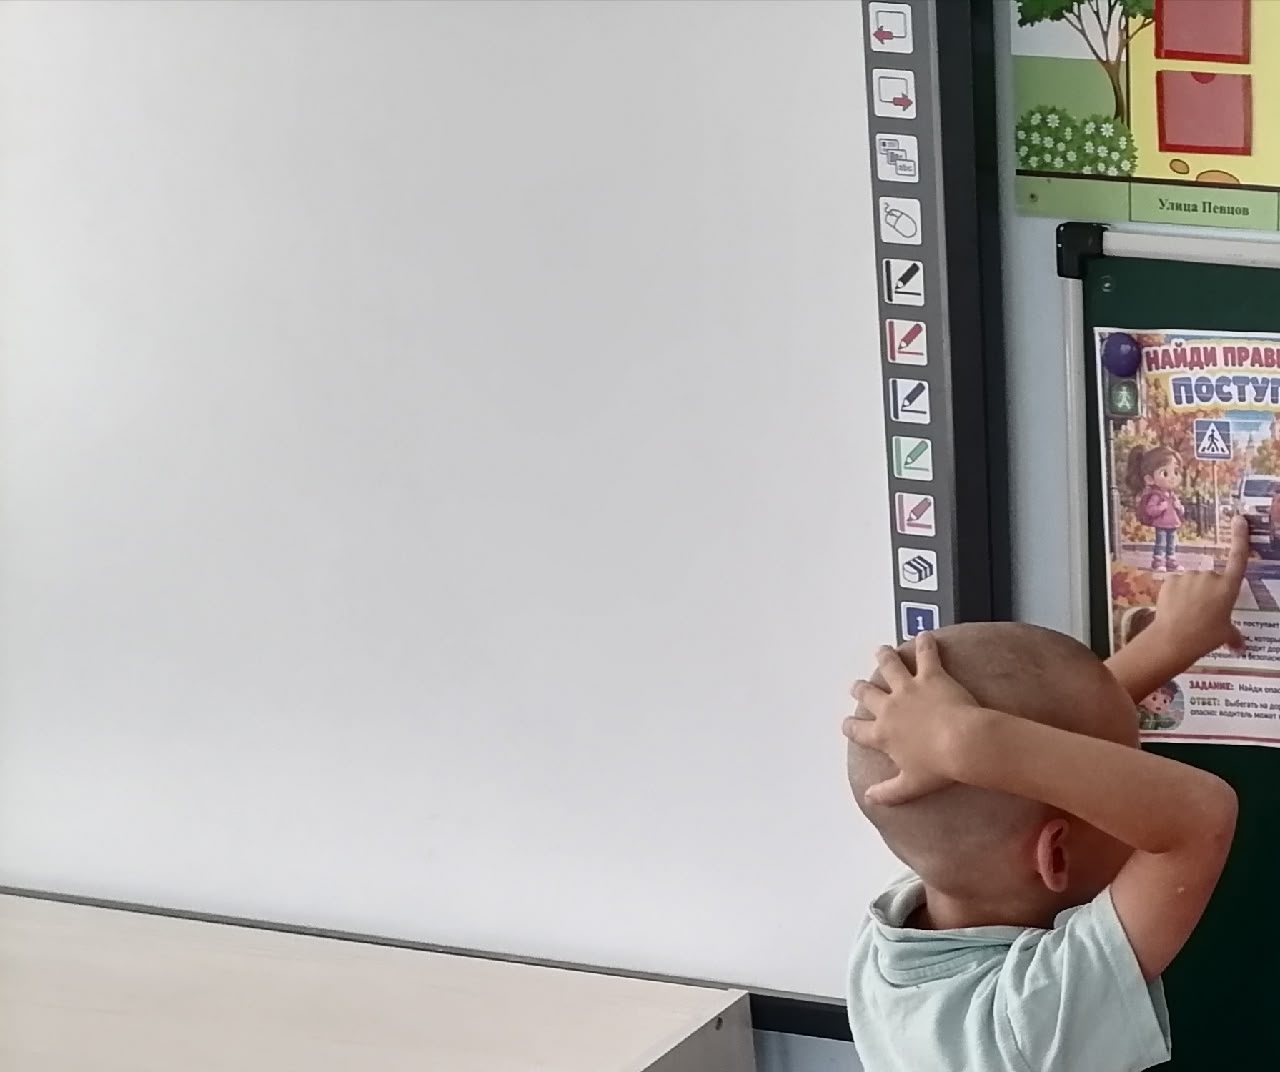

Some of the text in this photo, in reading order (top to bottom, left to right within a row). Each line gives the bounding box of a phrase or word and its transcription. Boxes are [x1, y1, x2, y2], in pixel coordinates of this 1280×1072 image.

[1158, 198, 1250, 216] Улица Певцов
[1145, 343, 1217, 372] НАЙДИ
[1243, 620, 1280, 631] поступает
[1189, 680, 1234, 691] ЗАДАНИЕ:
[1189, 698, 1220, 707] ОТВЕТ:
